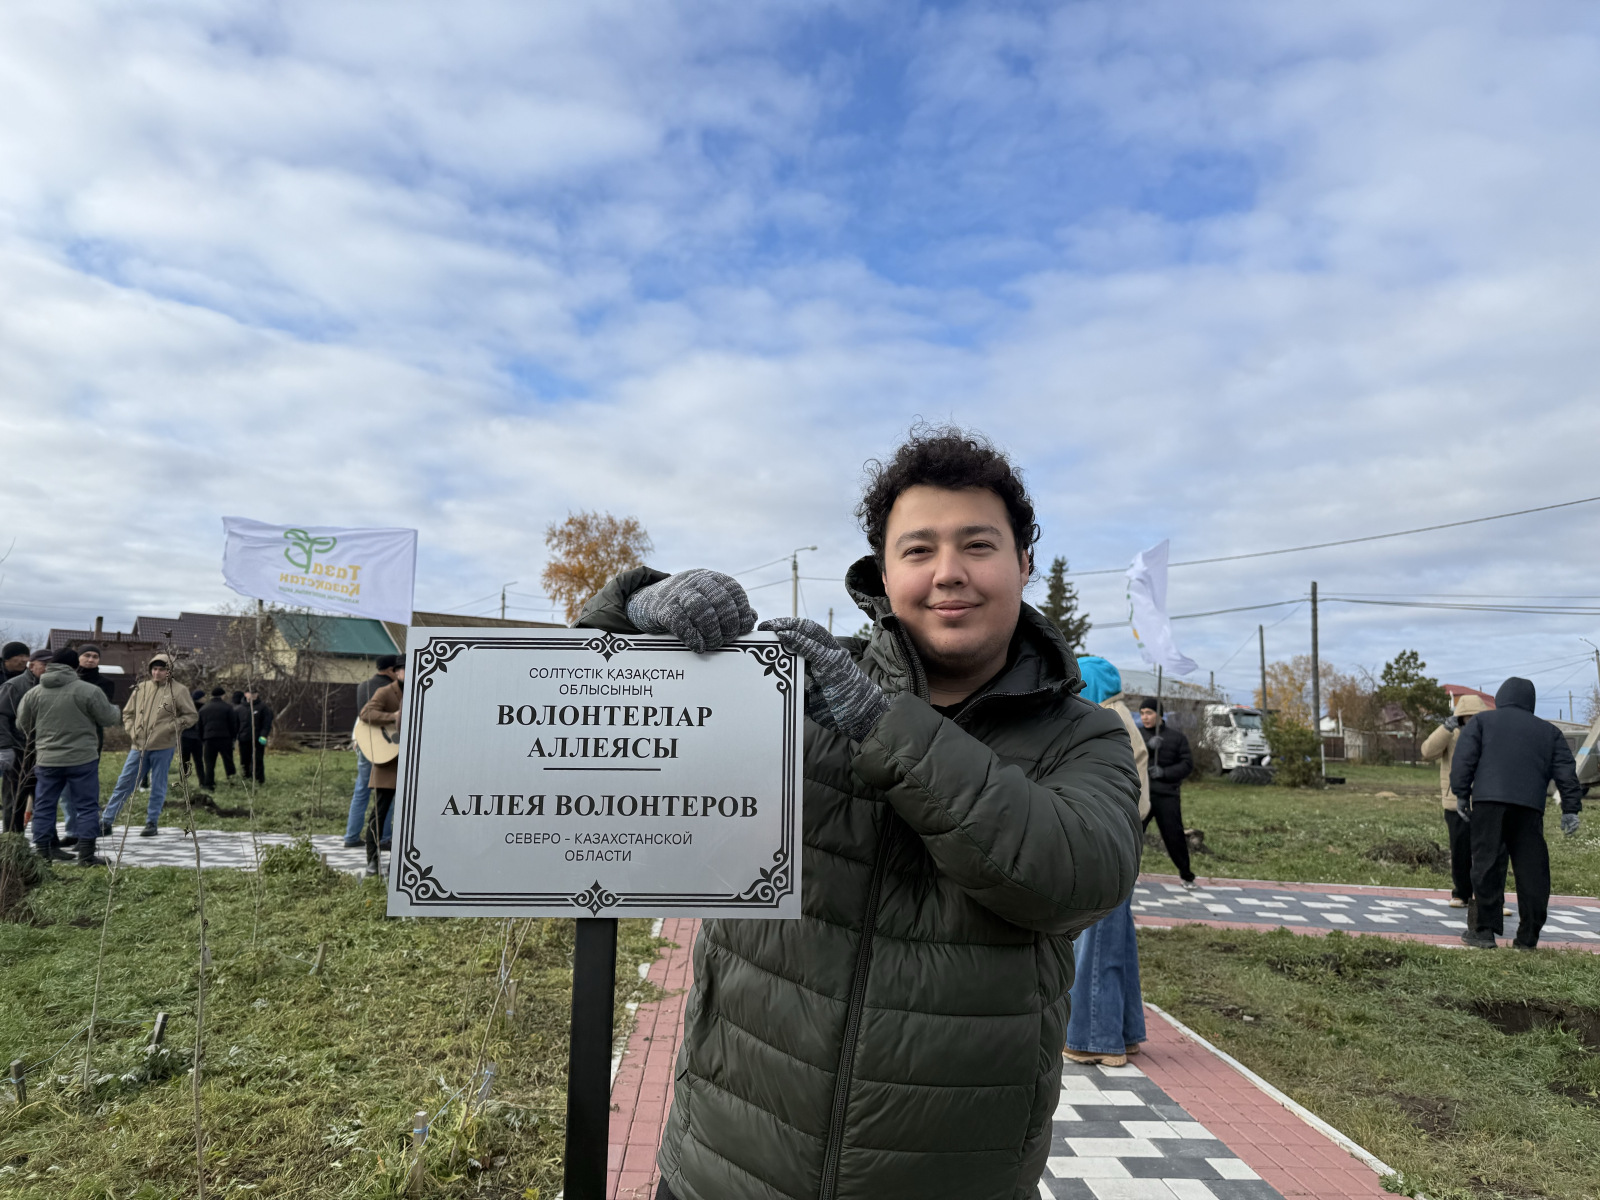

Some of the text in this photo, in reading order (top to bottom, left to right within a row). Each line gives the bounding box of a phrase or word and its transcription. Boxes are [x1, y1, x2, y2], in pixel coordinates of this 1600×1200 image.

[529, 667, 685, 682] СОЛТҮСТІК ҚАЗАҚСТАН
[559, 684, 653, 697] ОБЛЫСЫНЫҢ
[497, 704, 713, 727] ВОЛОНТЕРЛАР
[527, 737, 679, 759] АЛЛЕЯСЫ
[441, 794, 758, 818] АЛЛЕЯ ВОЛОНТЕРОВ
[504, 832, 561, 845] СЕВЕРО
[574, 831, 692, 845] КАЗАХСТАНСКОЙ
[564, 850, 632, 862] ОБЛАСТИ
